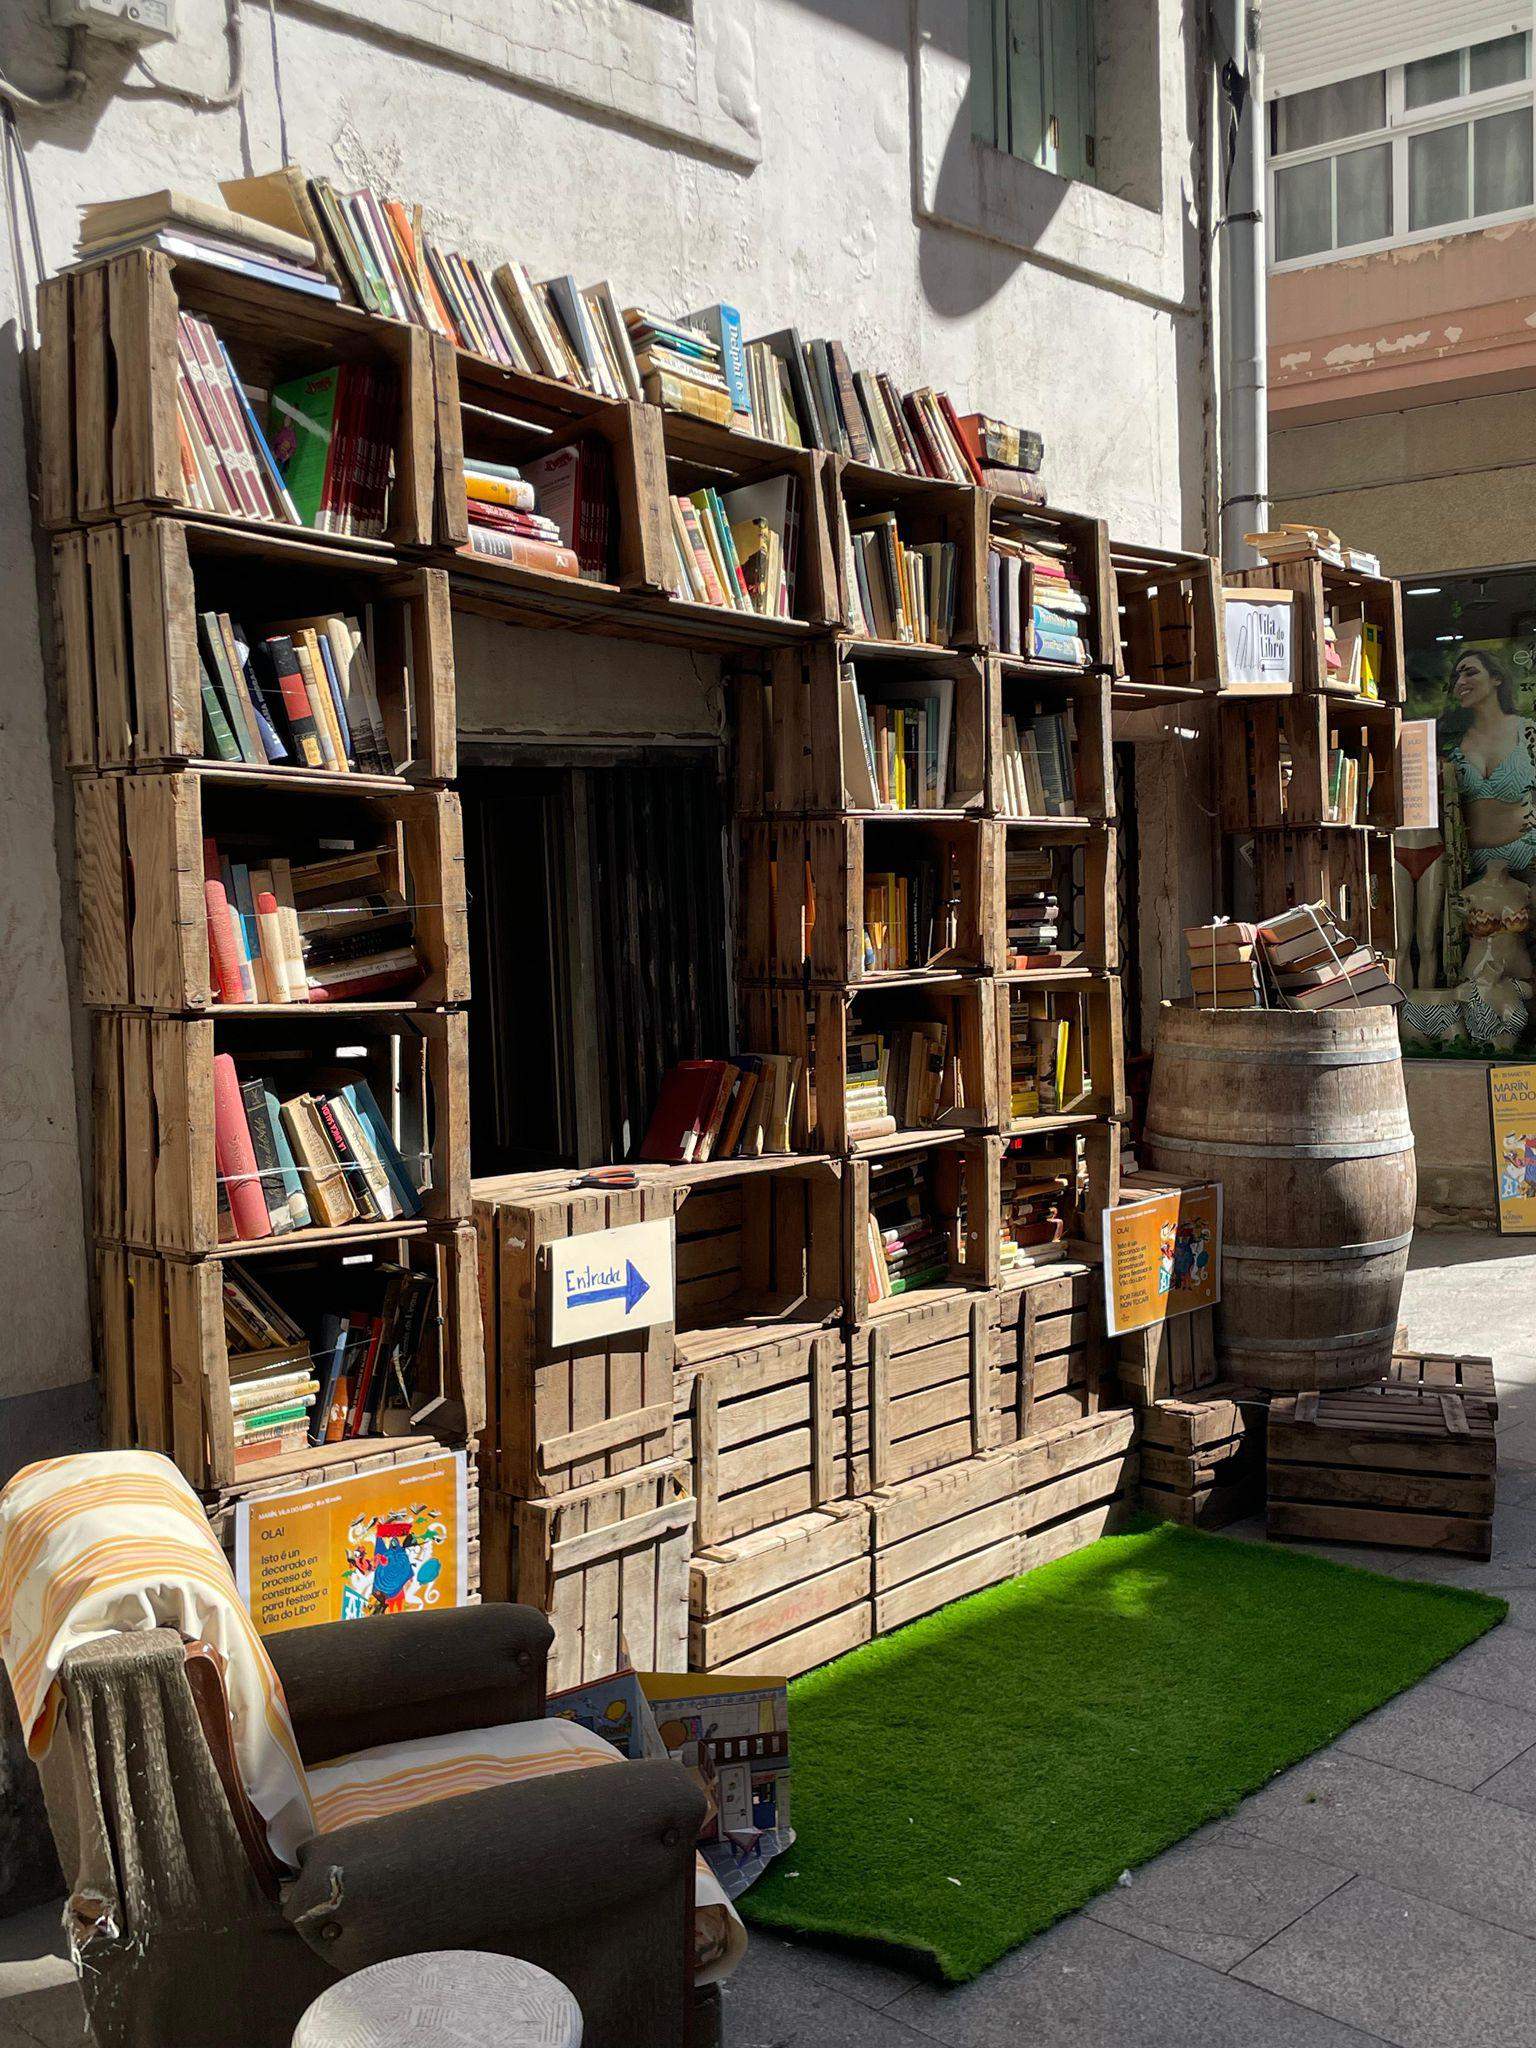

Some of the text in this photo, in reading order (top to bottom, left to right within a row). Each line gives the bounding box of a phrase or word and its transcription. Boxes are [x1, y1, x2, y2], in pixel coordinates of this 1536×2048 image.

[729, 325, 743, 378] Delphi
[1258, 613, 1276, 635] Vila
[1276, 627, 1285, 640] do
[1260, 637, 1285, 658] Libro
[1494, 1080, 1529, 1092] MARÍN
[1494, 1091, 1536, 1102] VILA DO
[565, 1265, 622, 1292] Entrada
[261, 1527, 285, 1541] OLA!
[261, 1549, 300, 1565] Isto é un
[261, 1556, 318, 1577] decorado en
[262, 1569, 313, 1591] proceso de
[262, 1580, 316, 1601] construción
[262, 1588, 328, 1615] para festexar a
[262, 1603, 316, 1624] Vila do Libro
